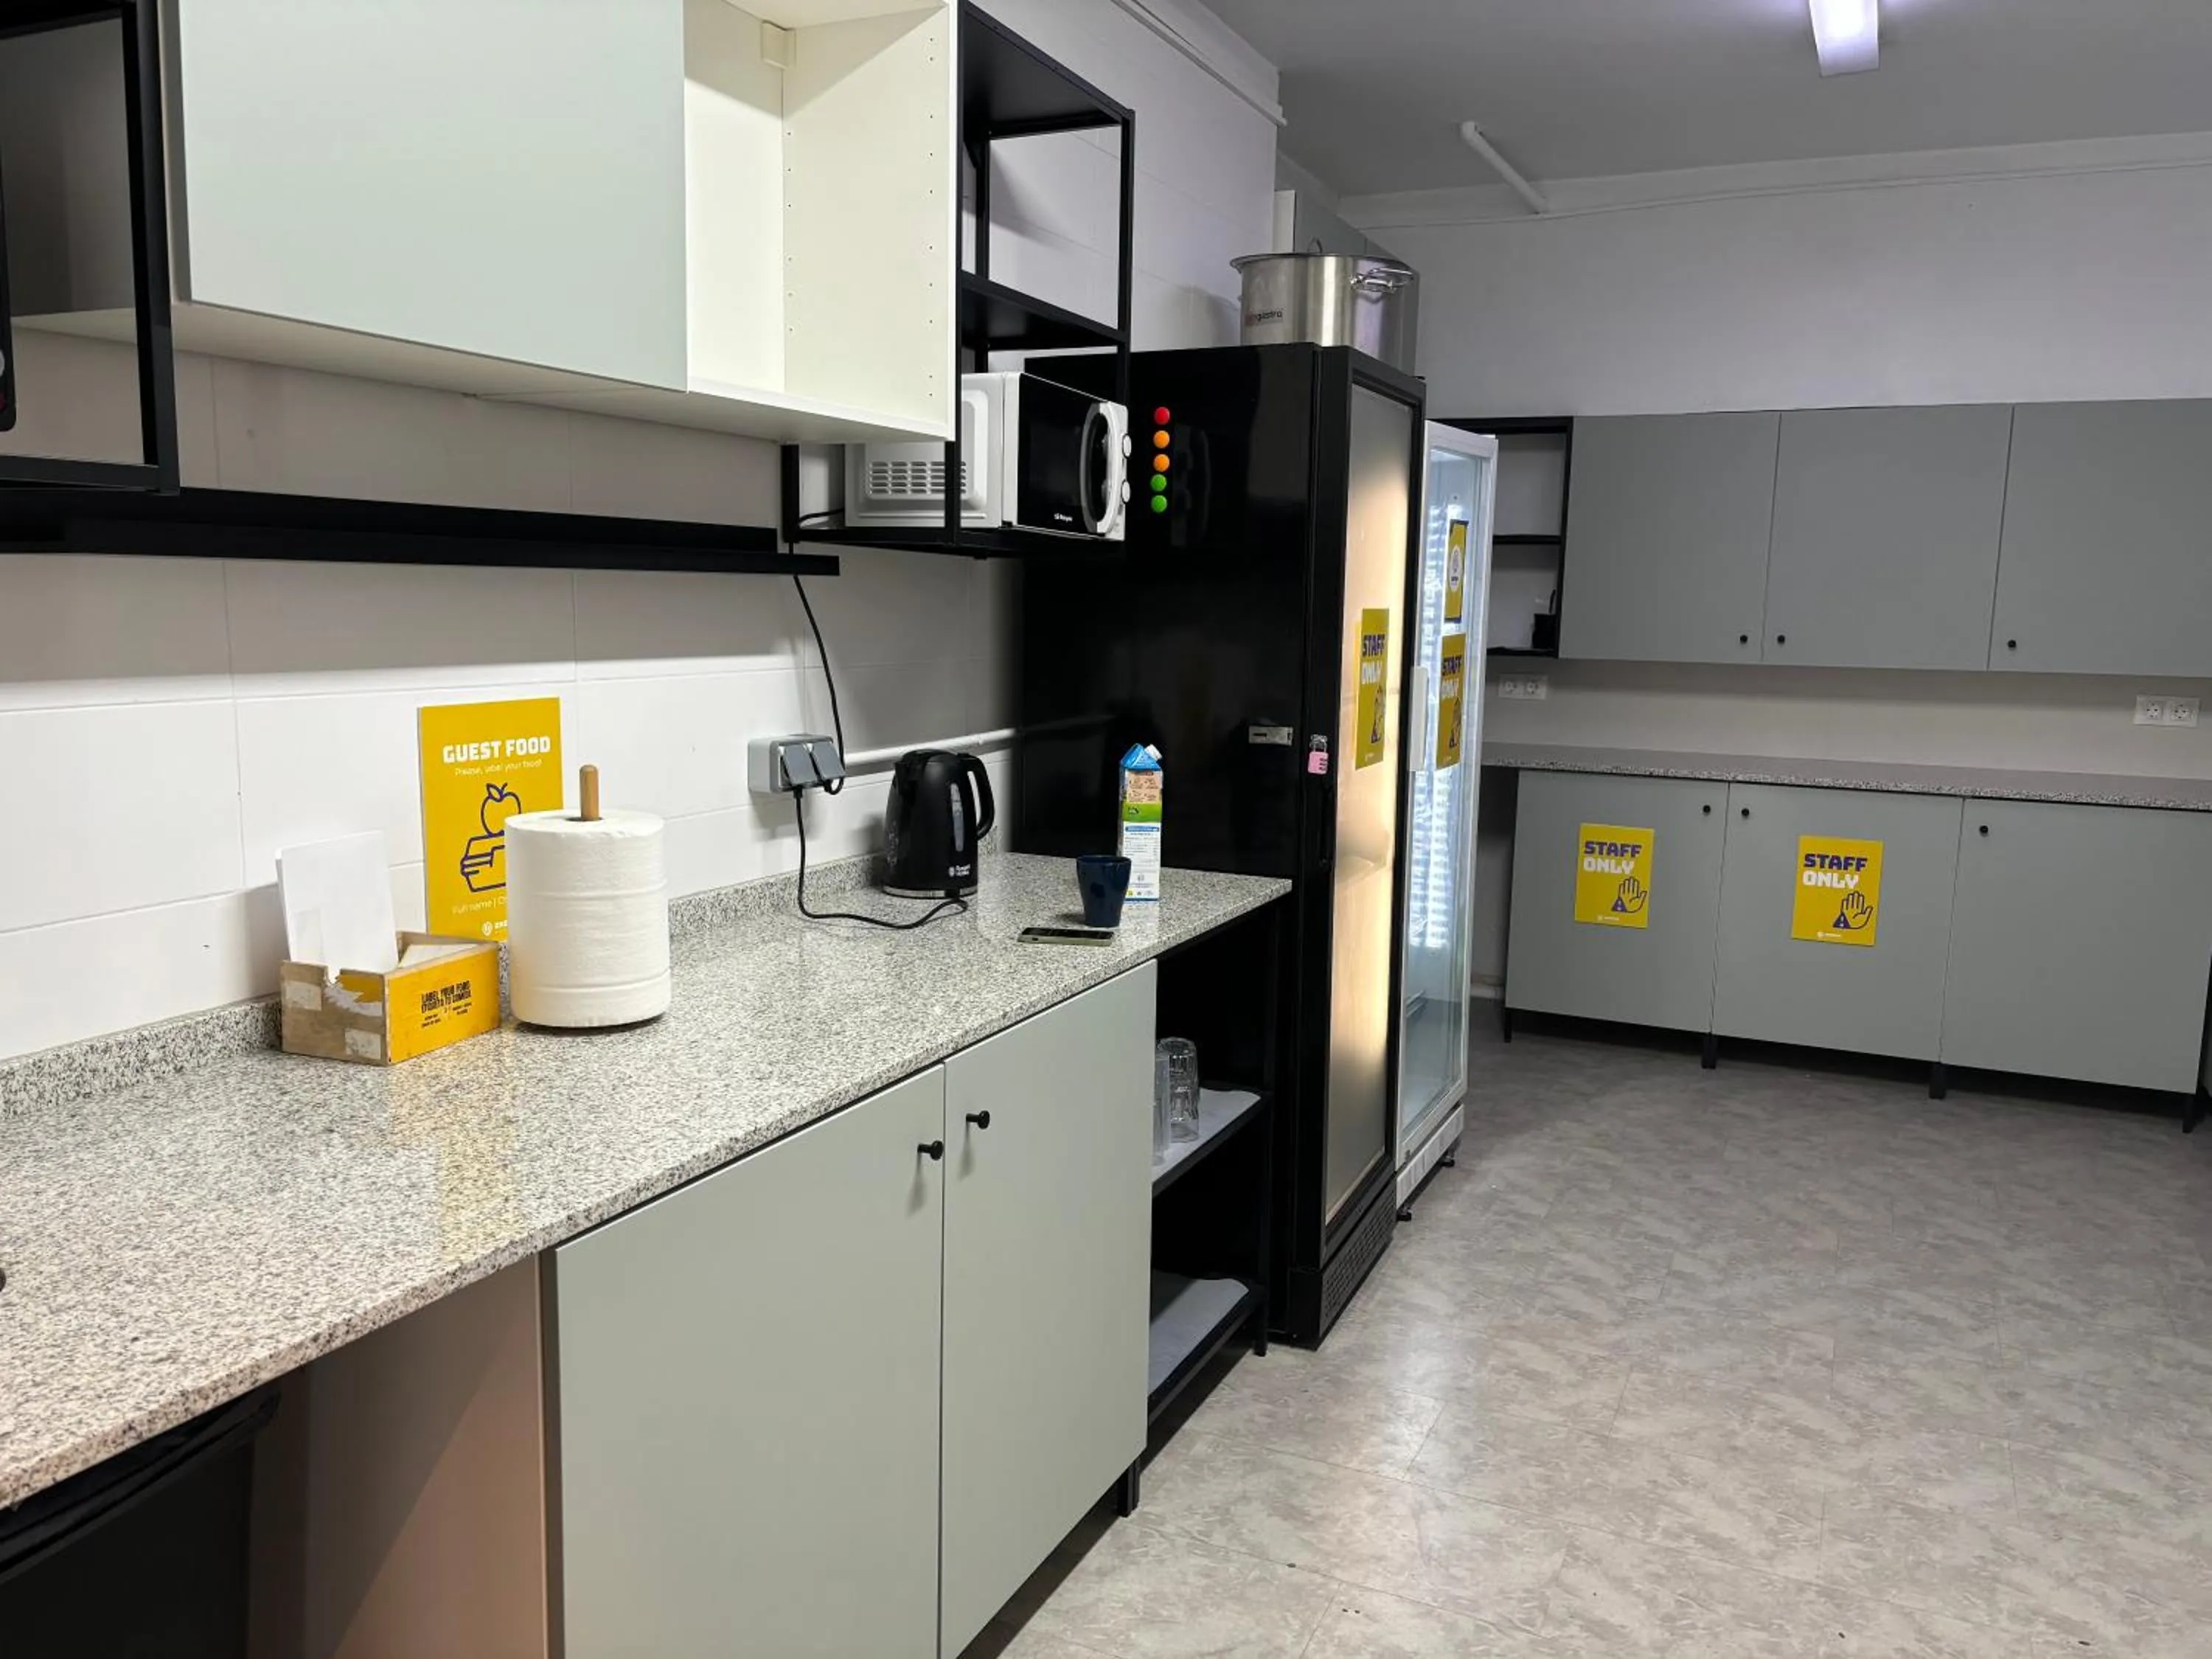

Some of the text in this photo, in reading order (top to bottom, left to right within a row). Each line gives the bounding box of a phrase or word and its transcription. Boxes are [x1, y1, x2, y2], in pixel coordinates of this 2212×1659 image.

[1362, 633, 1385, 658] STAFF
[443, 736, 552, 763] GUEST FOOD
[1584, 841, 1643, 858] STAFF
[1583, 857, 1635, 875] ONLY
[1804, 853, 1868, 872] STAFF
[1802, 870, 1859, 889] ONLY
